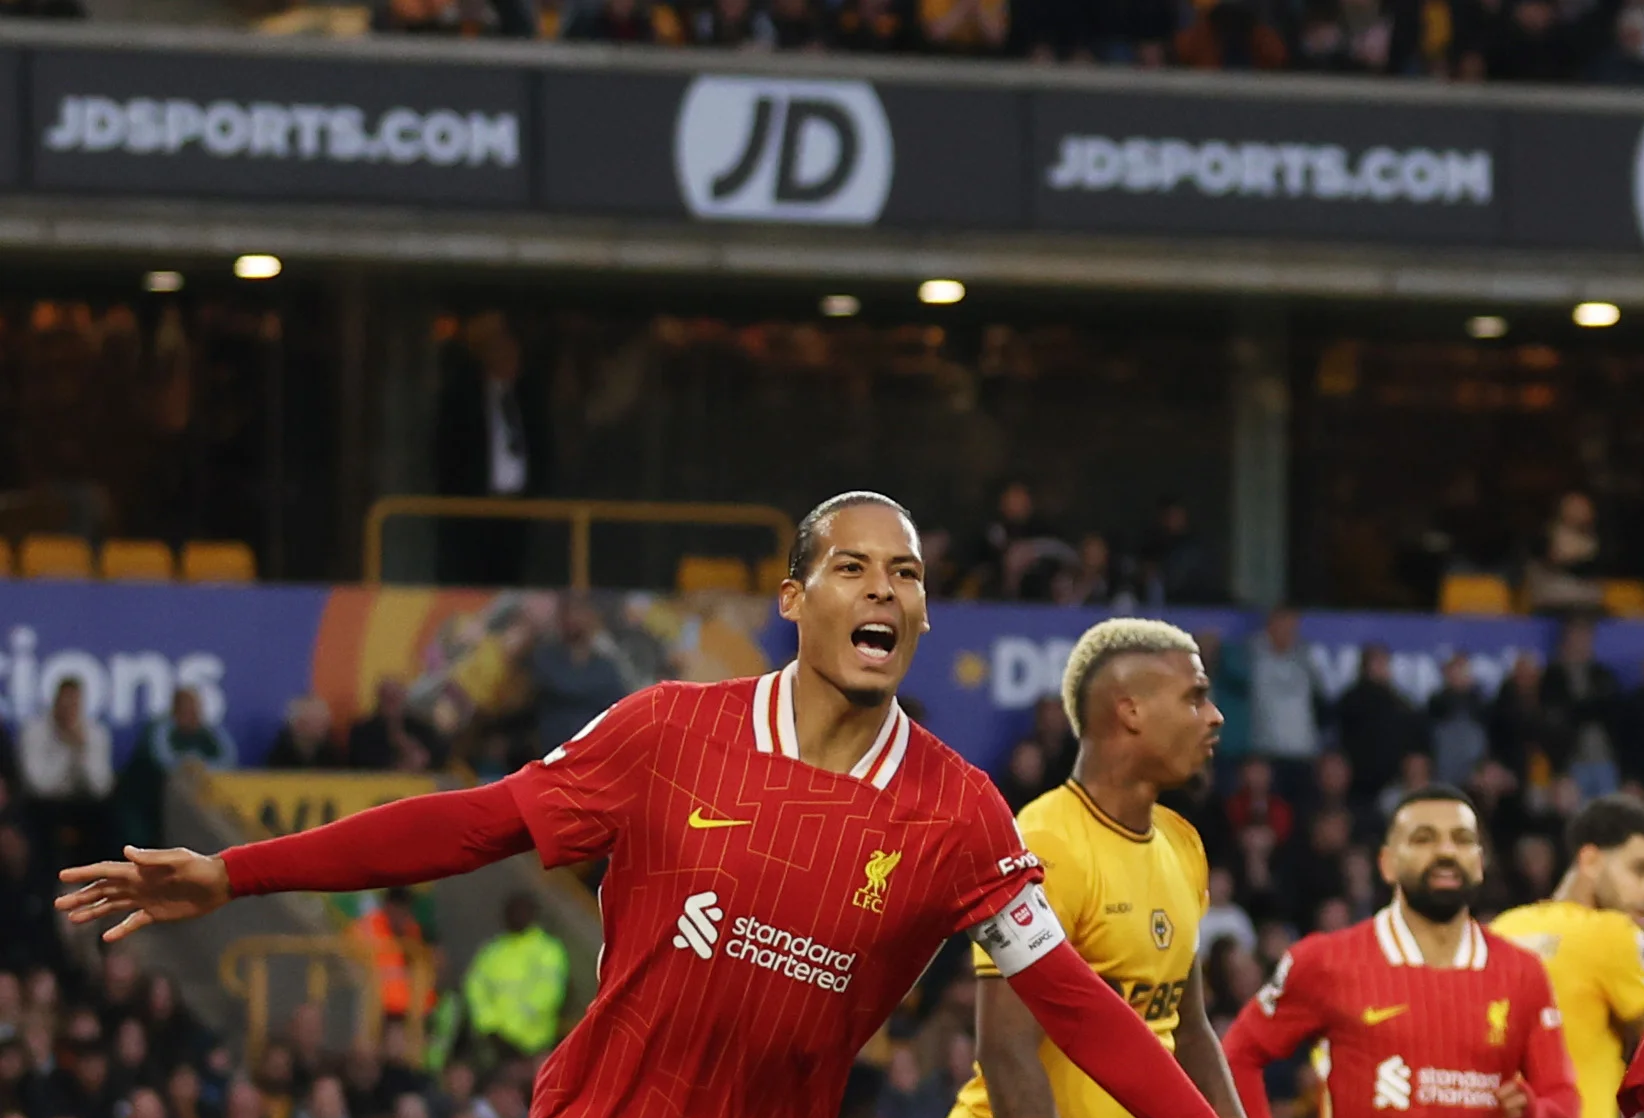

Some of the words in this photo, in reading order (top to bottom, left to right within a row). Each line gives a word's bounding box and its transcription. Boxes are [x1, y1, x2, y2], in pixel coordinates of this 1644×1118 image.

[45, 95, 521, 168] JDSPORTS.COM
[713, 94, 859, 203] JD
[1048, 134, 1492, 203] JDSPORTS.COM
[0, 625, 228, 726] ions
[725, 937, 853, 994] chartered
[732, 915, 858, 973] standard
